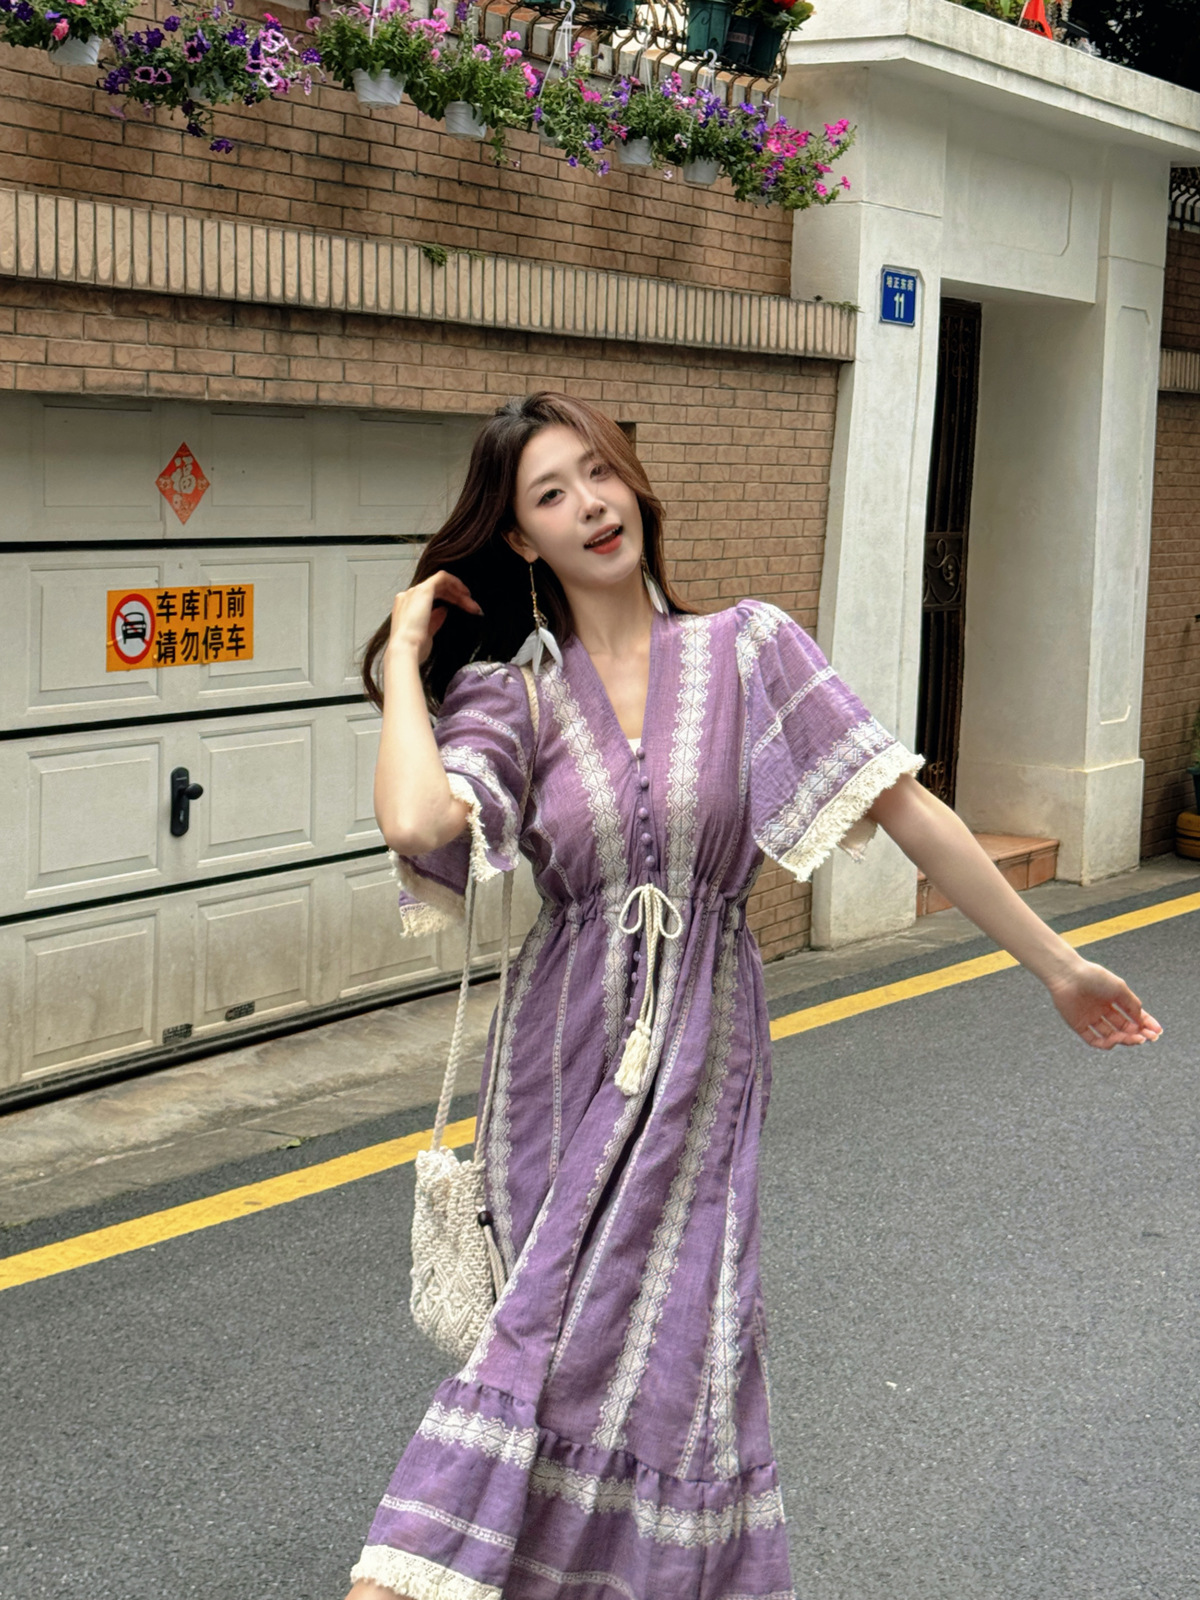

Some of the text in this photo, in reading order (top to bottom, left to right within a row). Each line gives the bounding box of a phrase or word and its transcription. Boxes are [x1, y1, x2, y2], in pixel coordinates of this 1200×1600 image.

[893, 292, 905, 319] 11
[171, 456, 197, 494] 福
[156, 587, 246, 623] 车库门前
[155, 624, 246, 664] 请勿停车
